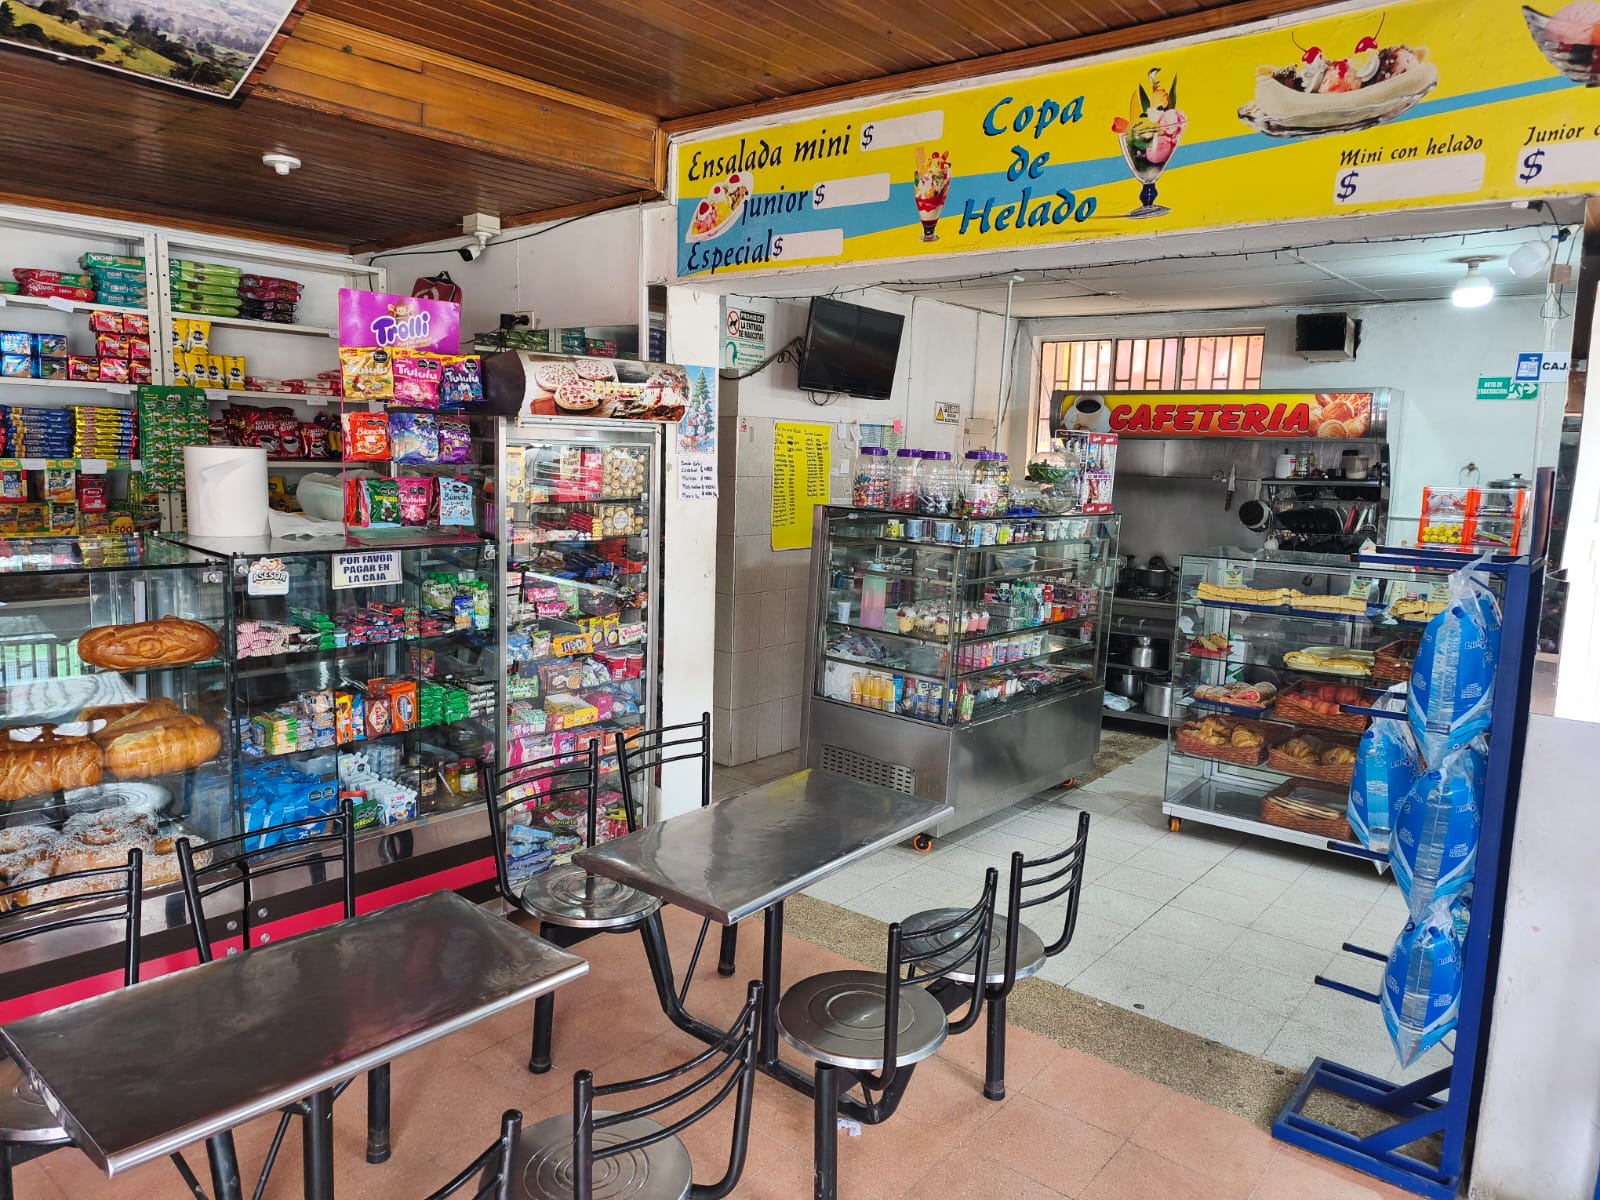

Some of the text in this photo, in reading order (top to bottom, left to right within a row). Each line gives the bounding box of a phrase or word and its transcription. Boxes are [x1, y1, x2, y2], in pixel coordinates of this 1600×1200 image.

[983, 95, 1085, 140] Copa
[1339, 133, 1482, 167] Mini con helado
[1523, 124, 1584, 146] Junior
[688, 123, 874, 182] Ensalada mini $
[1006, 145, 1051, 182] de
[1520, 148, 1545, 184] $
[1336, 169, 1359, 204] $
[741, 183, 826, 226] junior $
[958, 186, 1098, 237] Helado
[687, 228, 773, 274] Especial
[371, 311, 431, 347] Trolli
[746, 322, 763, 332] ENTRADA
[395, 363, 438, 381] Trululu
[1542, 362, 1568, 371] CAJ
[356, 427, 386, 437] Bianchi
[1108, 403, 1310, 433] CAFETERIA
[339, 554, 393, 566] POR FAVOR
[343, 564, 390, 574] PAGAR EN
[252, 571, 288, 583] ASESOR
[348, 573, 387, 583] LA CAJA
